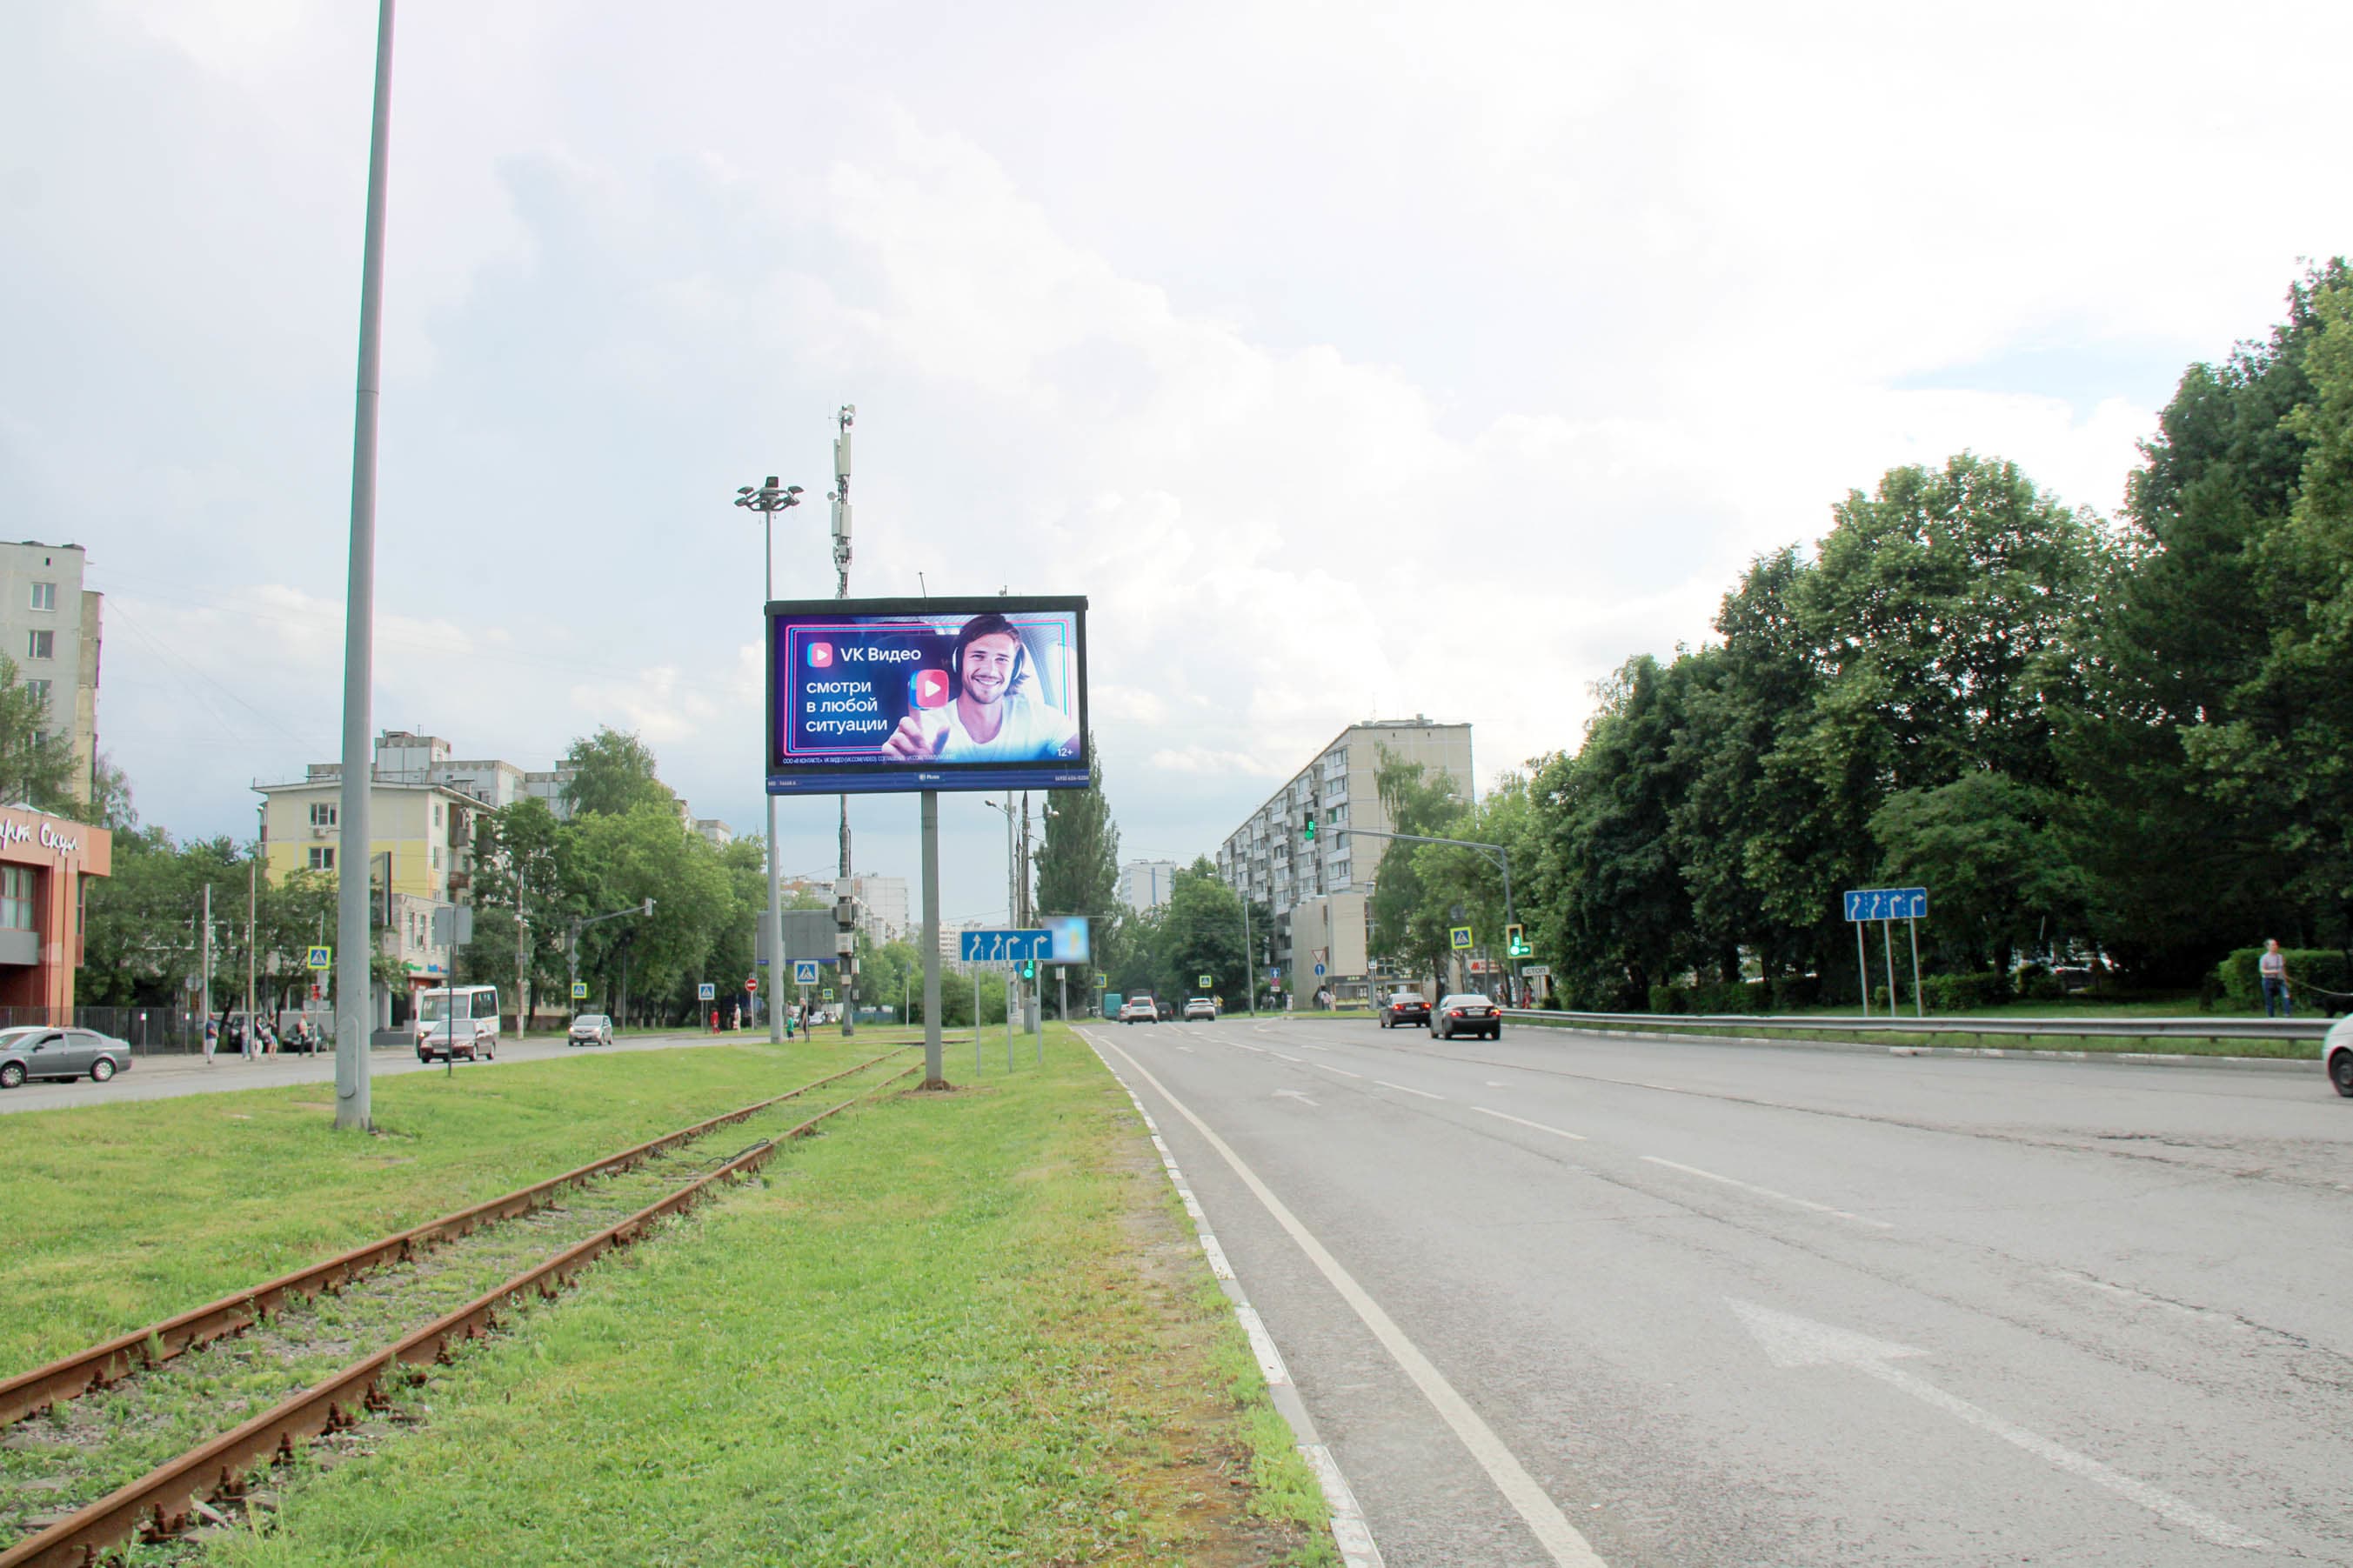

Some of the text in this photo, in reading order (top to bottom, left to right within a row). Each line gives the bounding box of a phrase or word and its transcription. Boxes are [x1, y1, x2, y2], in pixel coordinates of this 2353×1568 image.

[840, 647, 922, 664] VK Видео
[806, 681, 872, 697] смотри
[806, 697, 878, 712] в любой
[806, 719, 888, 735] ситуации
[1057, 748, 1073, 757] 12+
[39, 822, 80, 857] Скул
